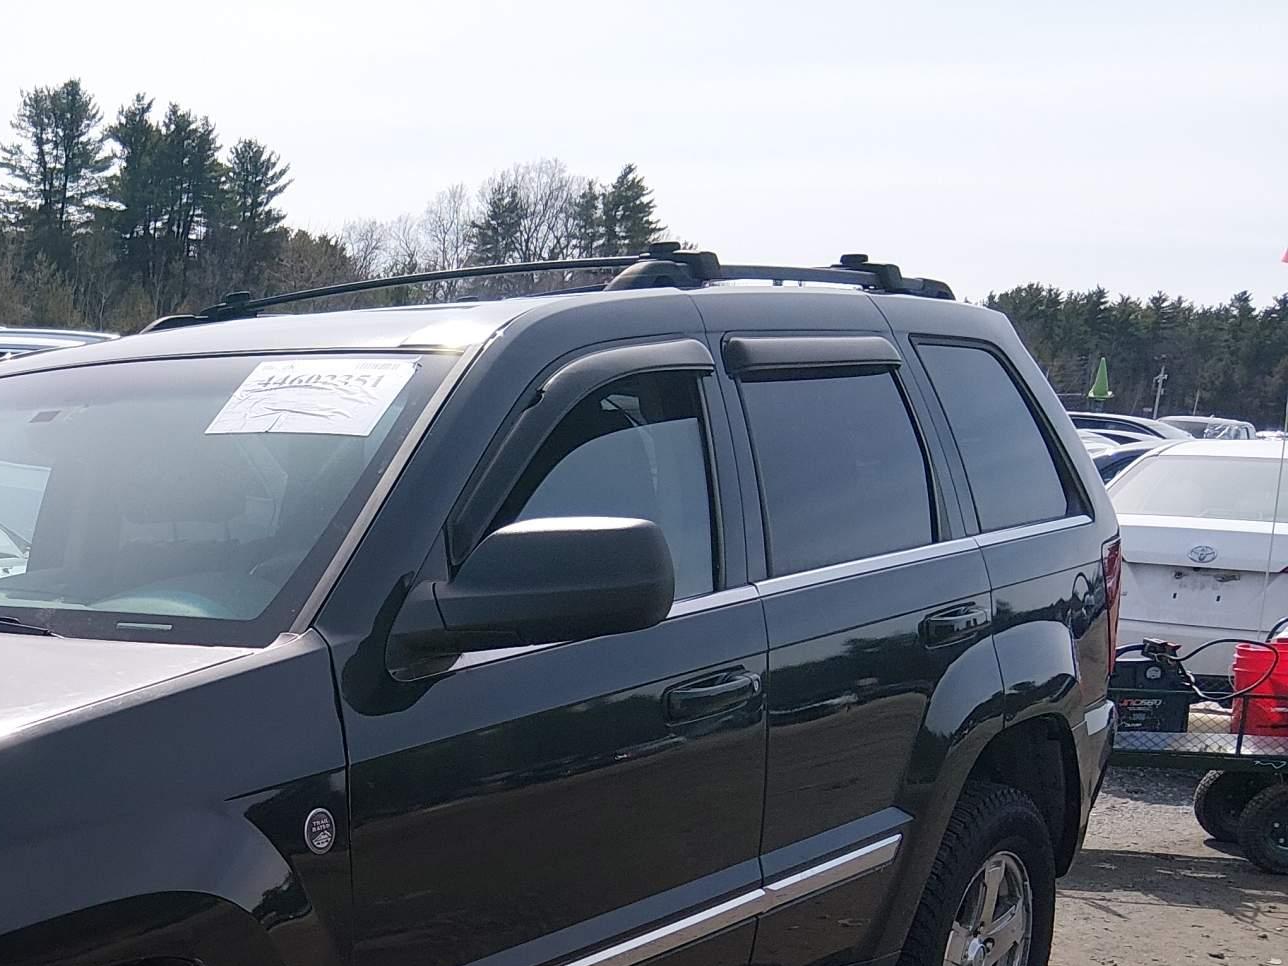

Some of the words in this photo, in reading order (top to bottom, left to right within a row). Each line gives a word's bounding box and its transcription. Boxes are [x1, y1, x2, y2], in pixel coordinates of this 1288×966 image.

[257, 374, 386, 389] 44602351
[312, 818, 329, 827] TRAIL
[312, 823, 331, 833] RATED
